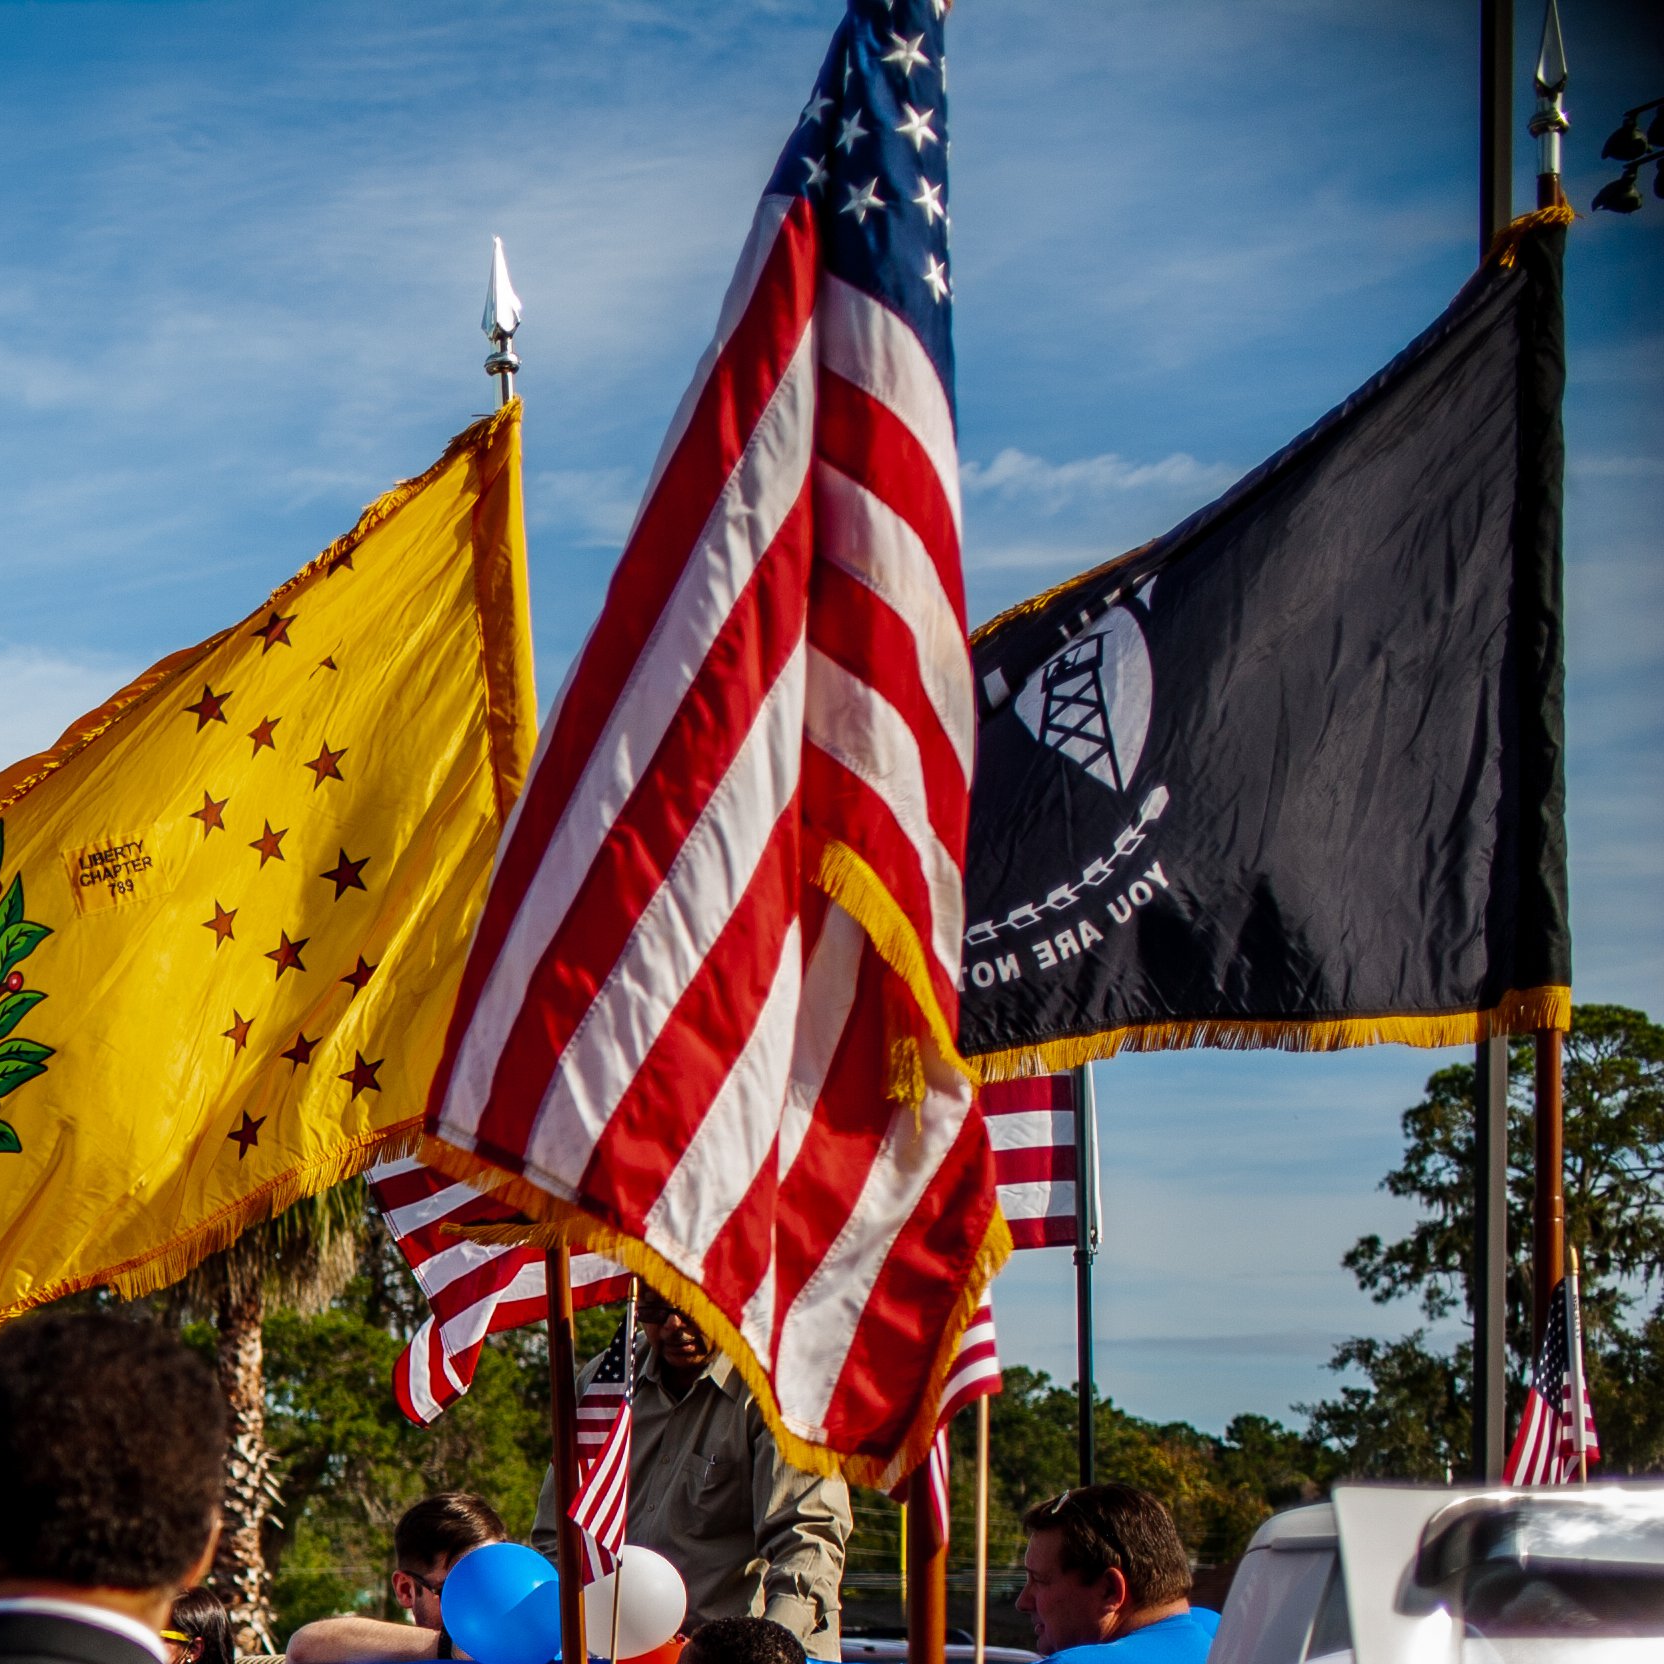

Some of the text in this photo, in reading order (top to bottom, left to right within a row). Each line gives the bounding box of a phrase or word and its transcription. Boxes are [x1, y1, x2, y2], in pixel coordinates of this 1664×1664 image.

[79, 840, 143, 870] LIBERTY
[79, 856, 153, 887] CHAPTER
[108, 879, 134, 897] 789
